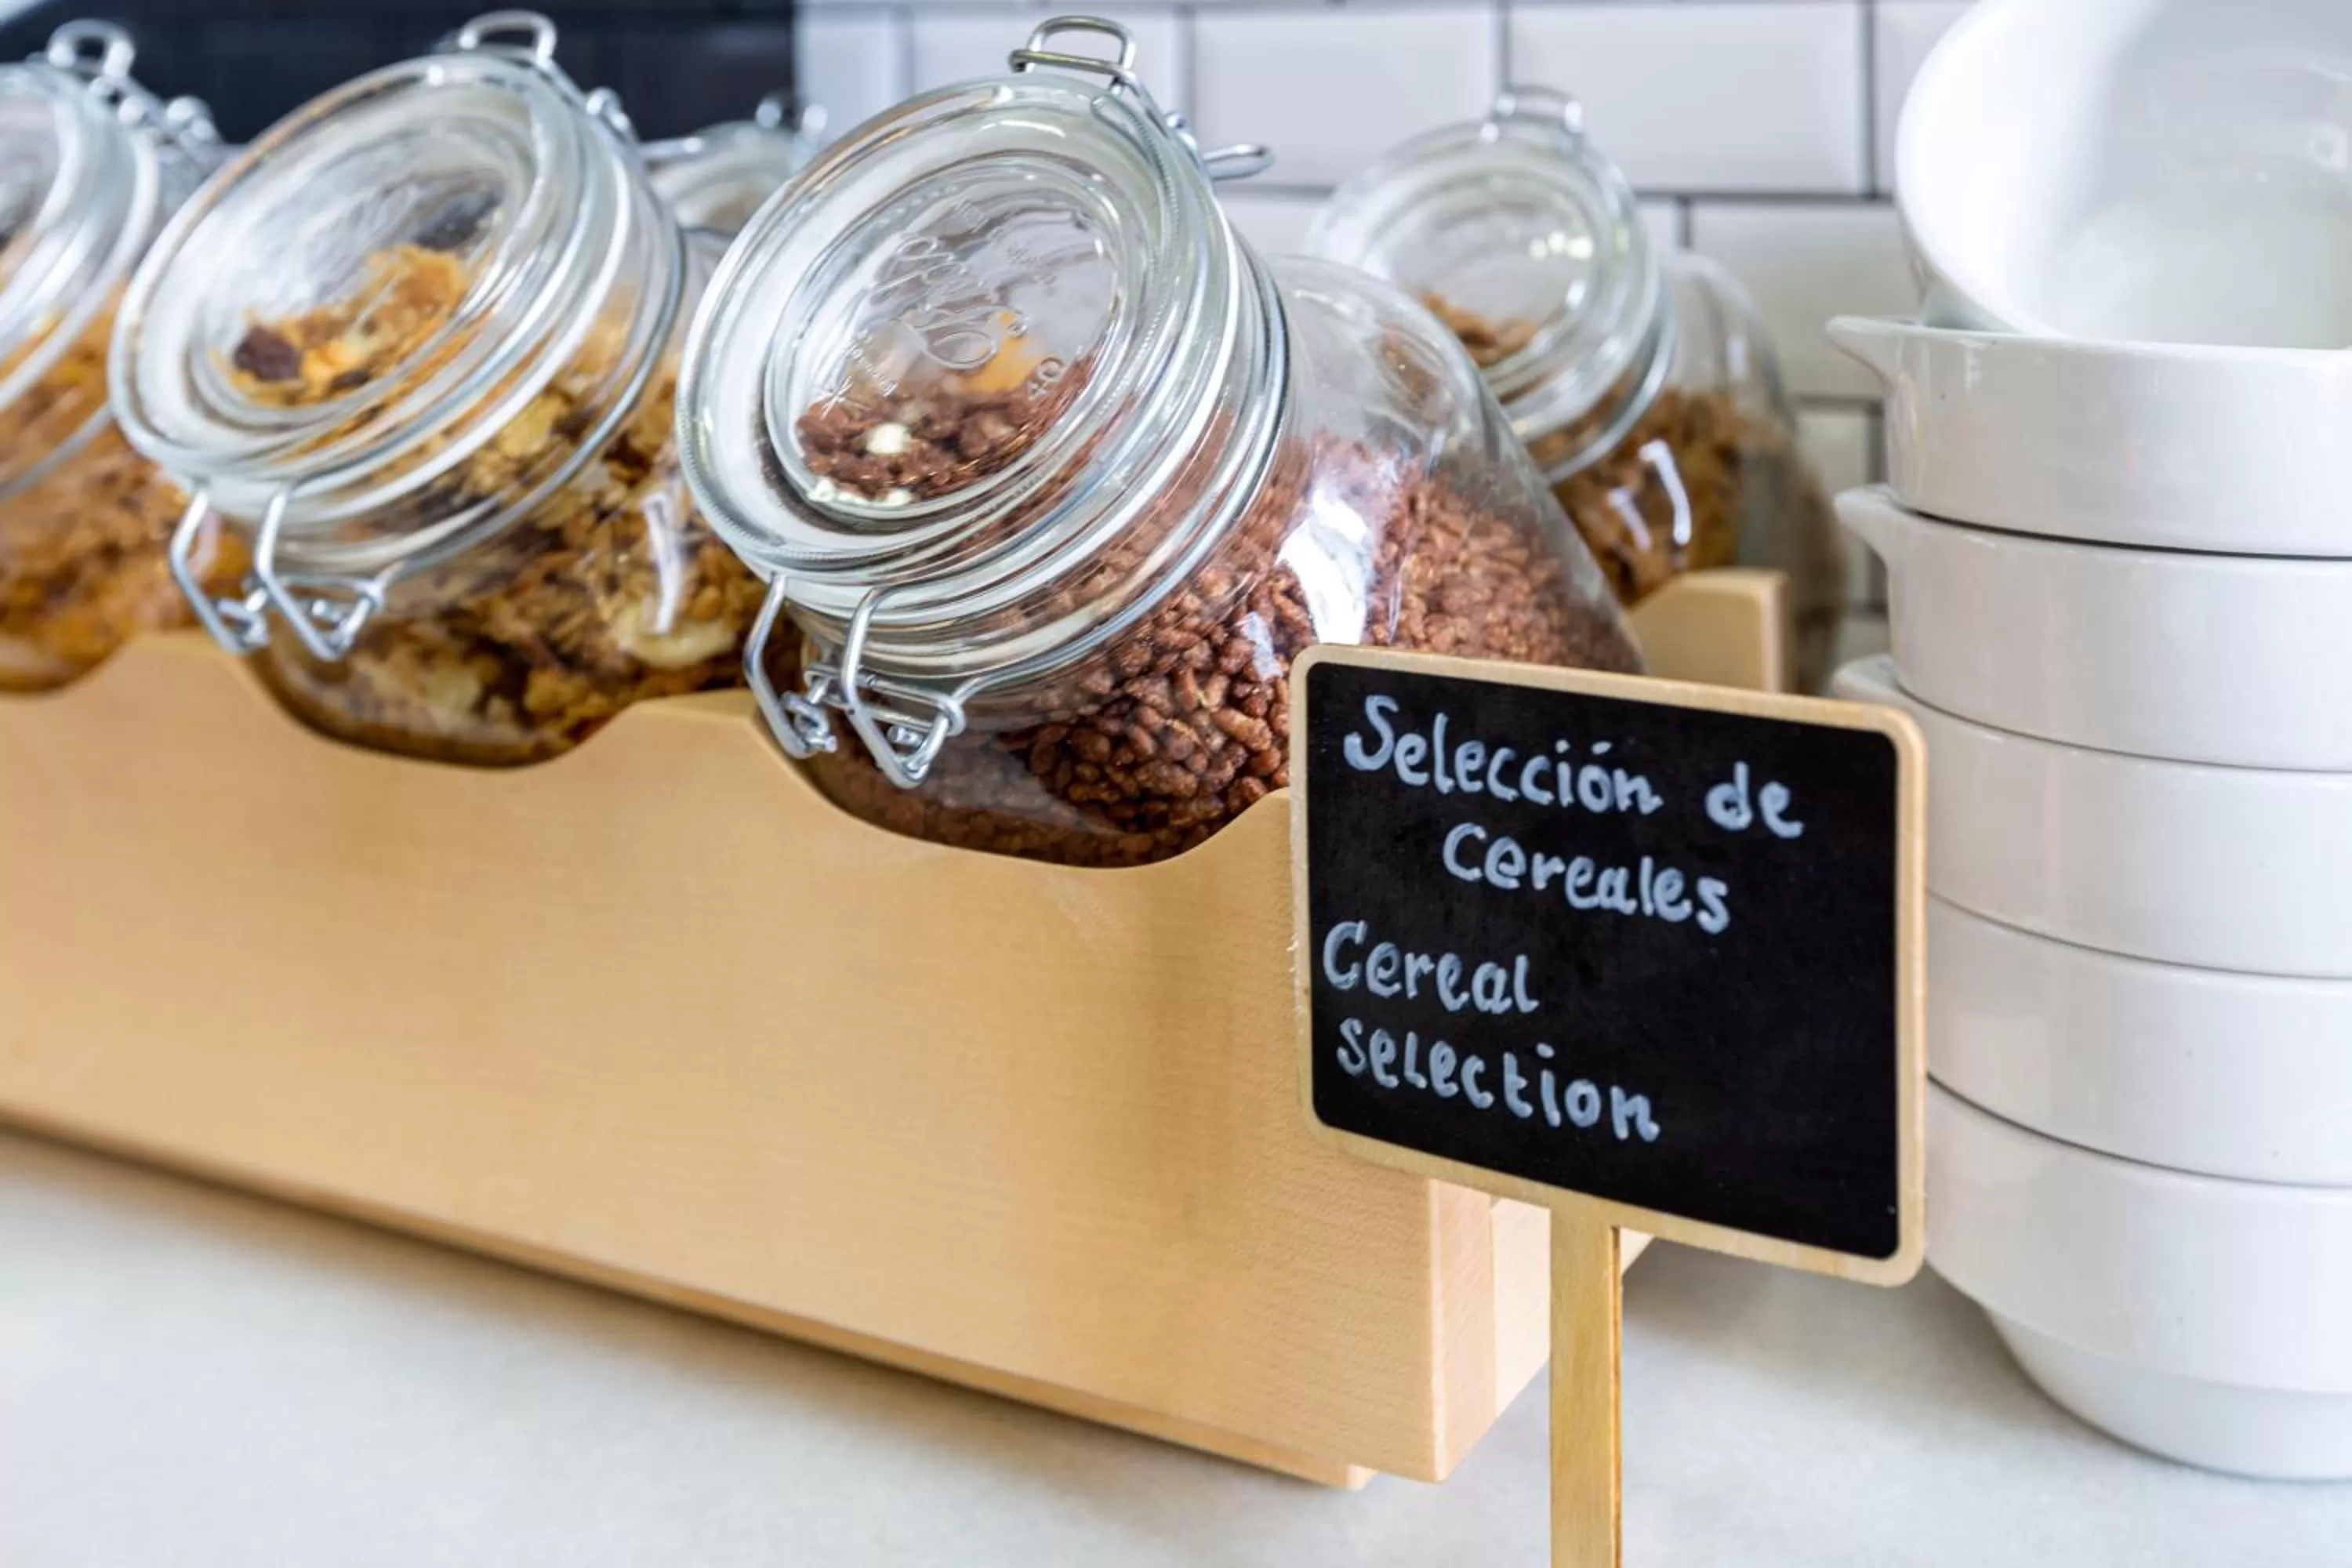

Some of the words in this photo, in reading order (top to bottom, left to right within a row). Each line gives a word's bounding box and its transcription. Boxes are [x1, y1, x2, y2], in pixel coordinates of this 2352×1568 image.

[1343, 694, 1664, 815] Selección
[1706, 762, 1803, 838] de
[1322, 920, 1540, 1014] Cereal
